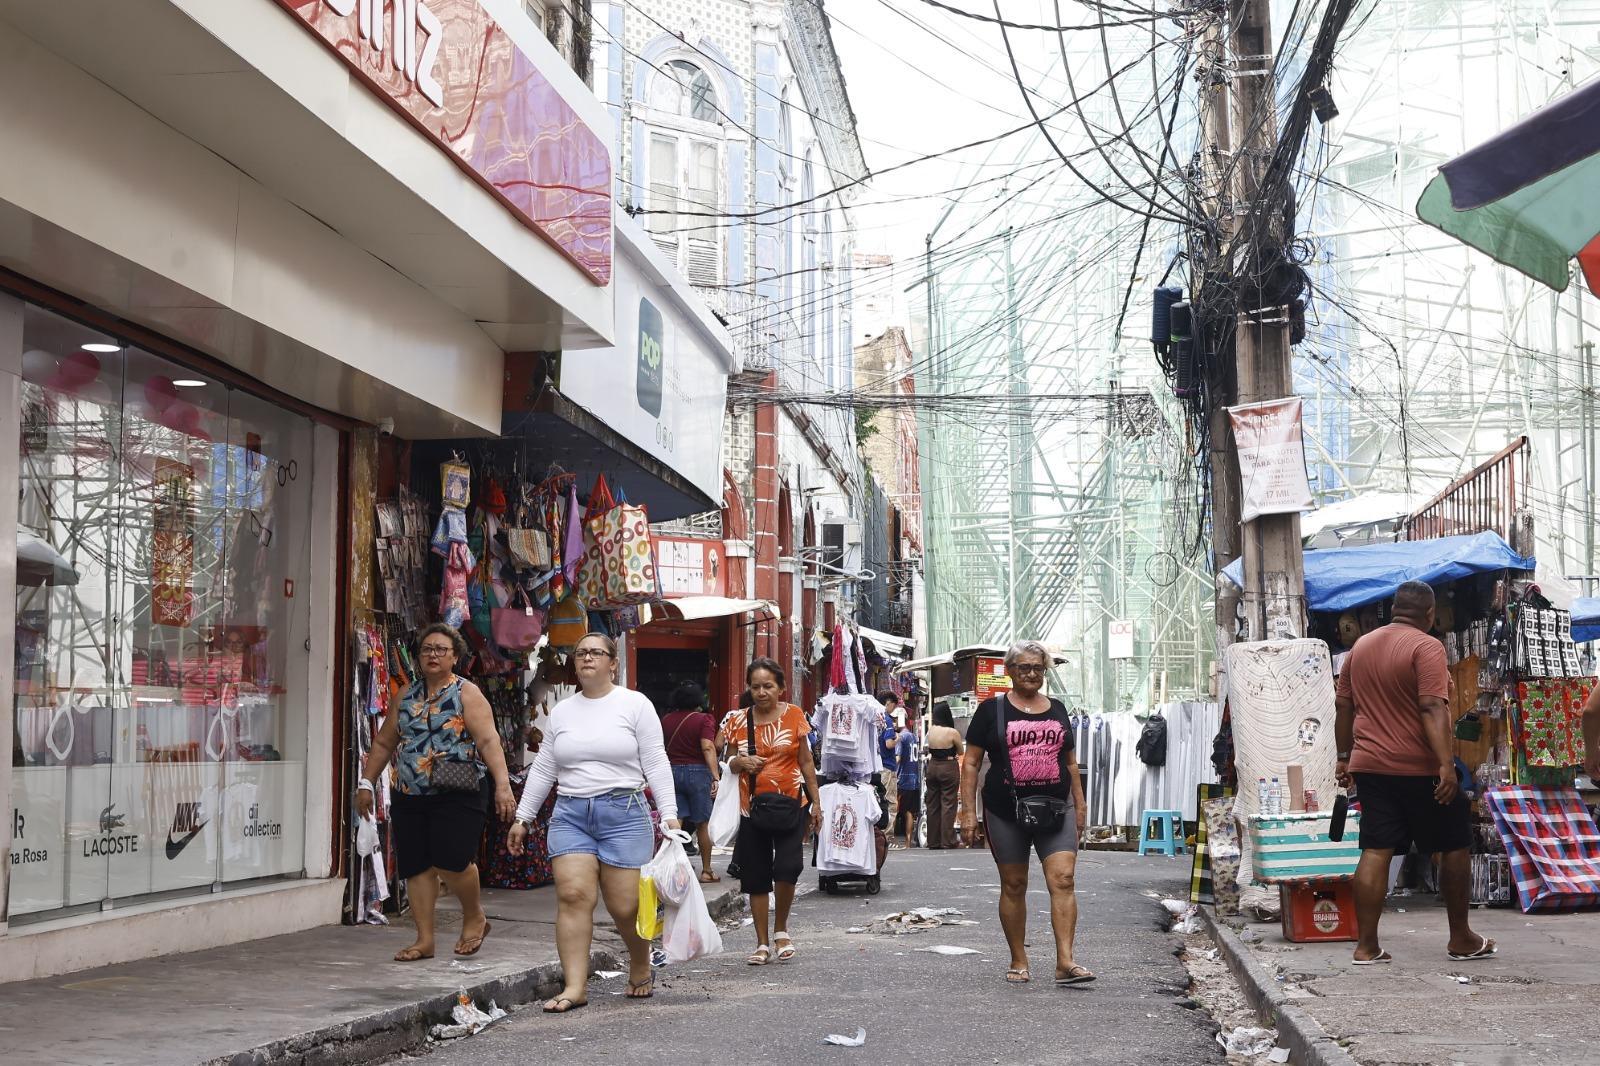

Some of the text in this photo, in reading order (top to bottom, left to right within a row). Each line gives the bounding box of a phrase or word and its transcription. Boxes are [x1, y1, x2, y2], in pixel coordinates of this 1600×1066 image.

[641, 331, 660, 370] POP
[909, 743, 918, 762] 10
[172, 802, 201, 833] NIKE
[243, 820, 281, 838] collection
[23, 848, 48, 863] Rosa
[83, 835, 138, 857] LACOSTE
